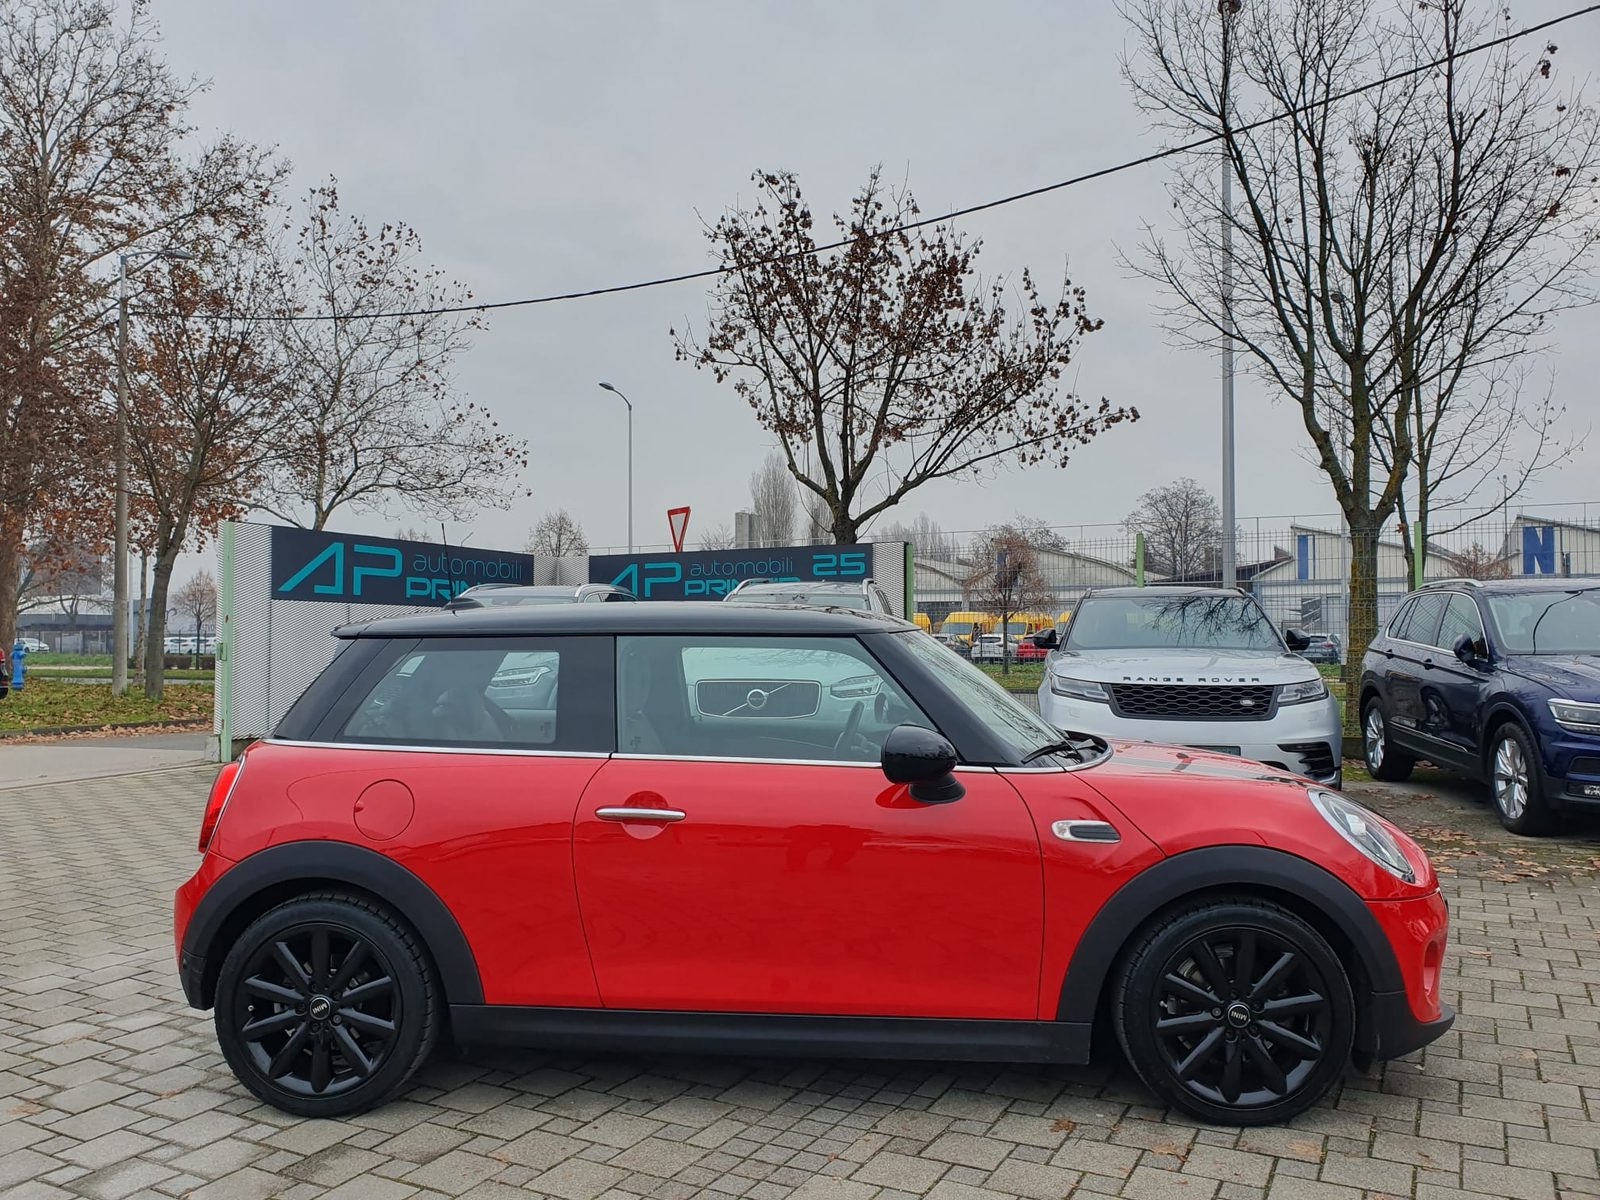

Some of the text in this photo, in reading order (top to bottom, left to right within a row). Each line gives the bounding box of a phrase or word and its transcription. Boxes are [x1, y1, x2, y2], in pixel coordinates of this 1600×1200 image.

[277, 542, 403, 595] AP
[413, 551, 522, 579] automobili
[690, 556, 793, 577] automobili
[812, 552, 866, 576] 25
[610, 562, 682, 597] AP
